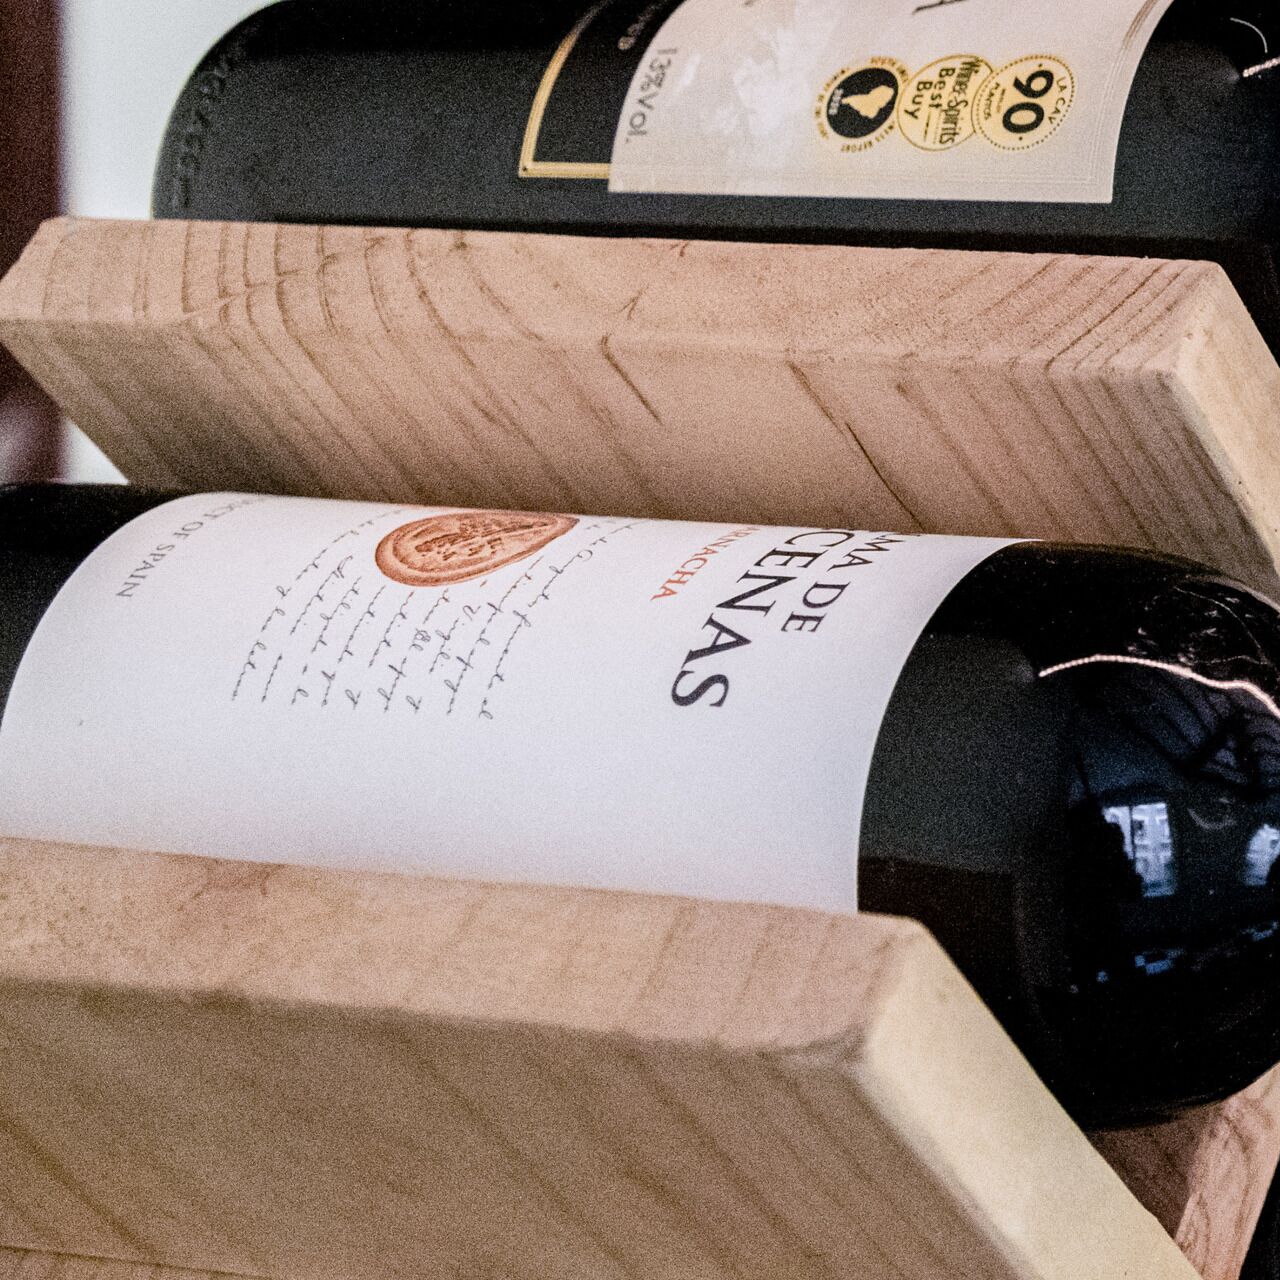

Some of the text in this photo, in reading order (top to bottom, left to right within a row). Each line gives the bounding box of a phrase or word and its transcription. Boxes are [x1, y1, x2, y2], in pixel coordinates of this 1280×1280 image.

[903, 80, 933, 120] Buy
[928, 67, 955, 110] Best
[1001, 69, 1055, 134] 90
[116, 521, 203, 598] OF SPAIN
[670, 529, 856, 708] CENAS
[780, 581, 851, 633] DE
